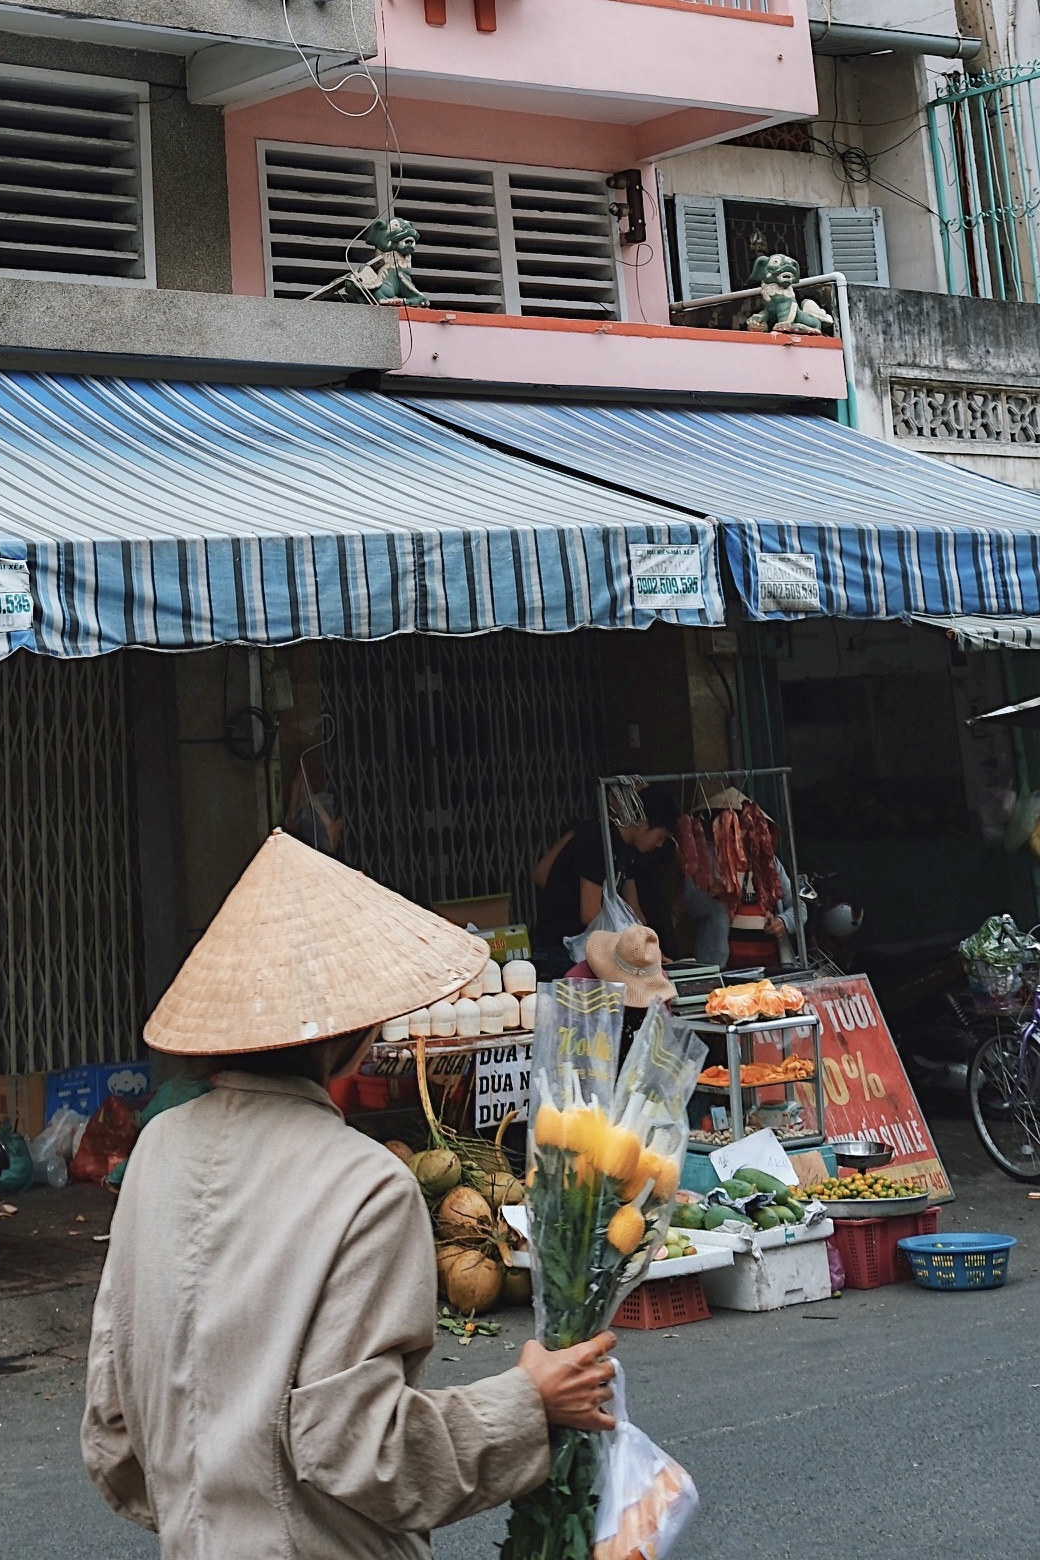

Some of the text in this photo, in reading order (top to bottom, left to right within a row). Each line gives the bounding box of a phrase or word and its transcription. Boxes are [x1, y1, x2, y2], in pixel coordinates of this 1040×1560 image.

[637, 577, 699, 594] 0902.509.535
[760, 583, 818, 600] 0902.509.535
[479, 1070, 514, 1095] DỪA
